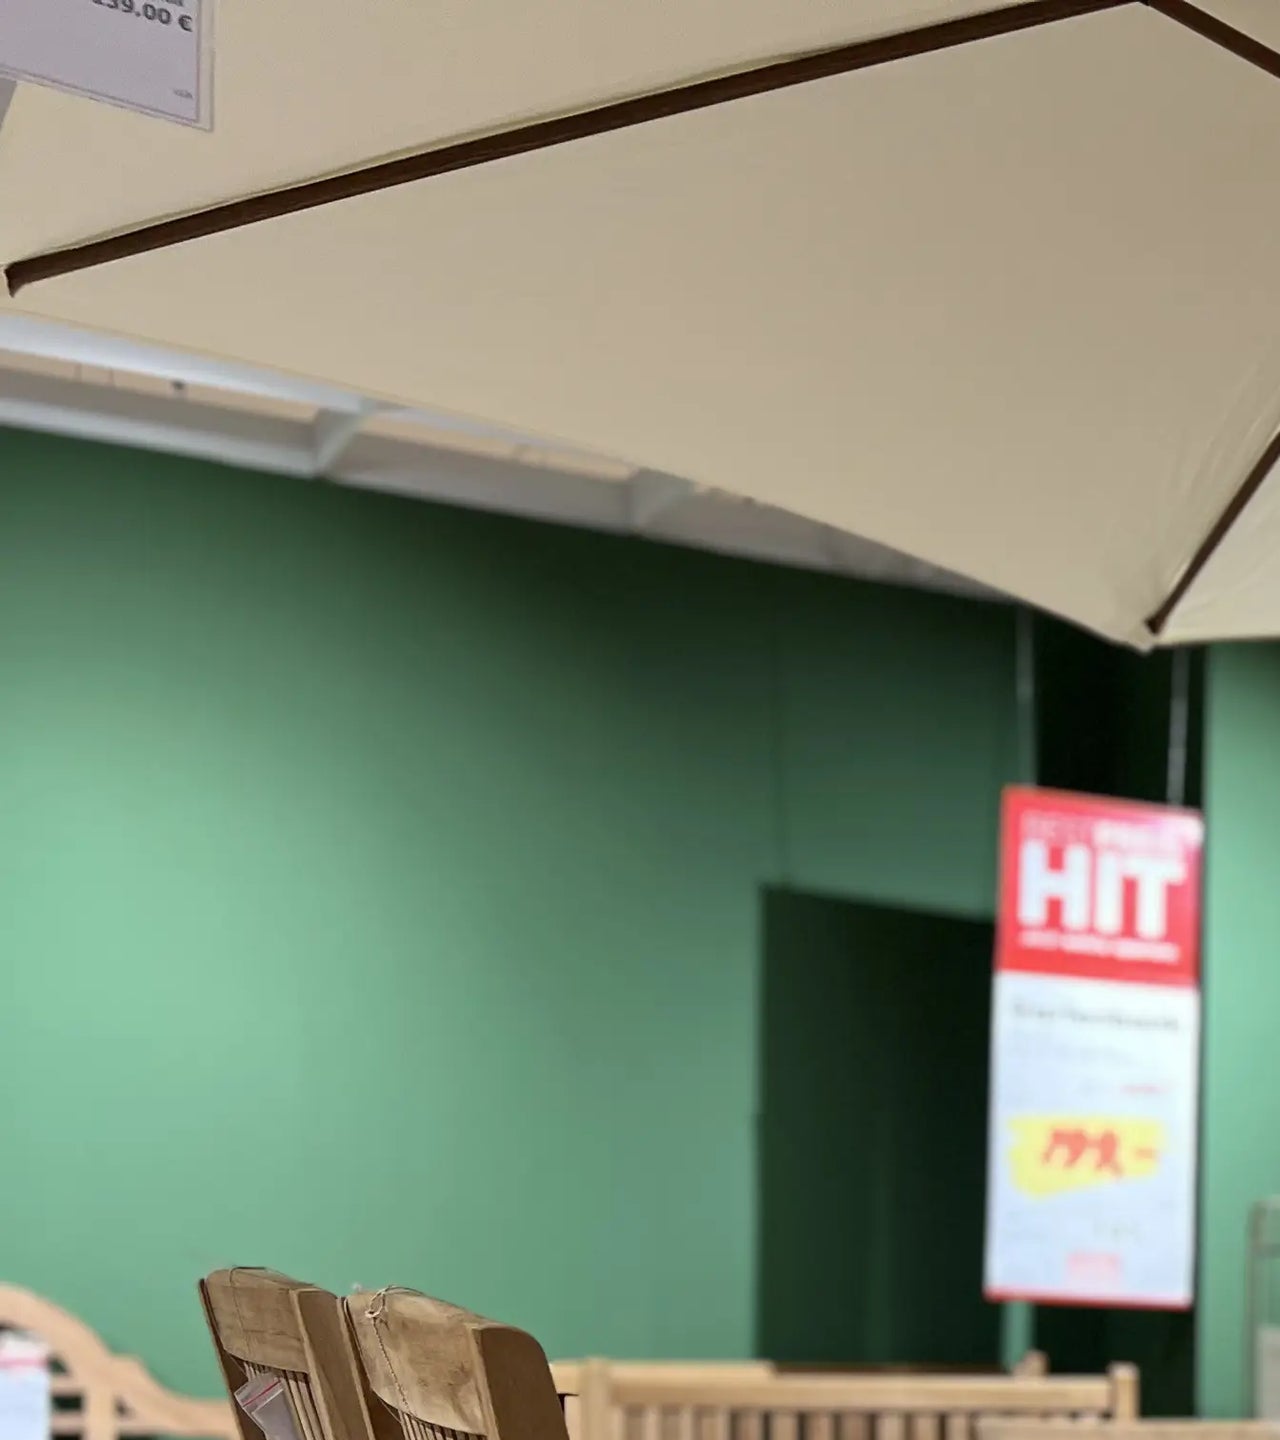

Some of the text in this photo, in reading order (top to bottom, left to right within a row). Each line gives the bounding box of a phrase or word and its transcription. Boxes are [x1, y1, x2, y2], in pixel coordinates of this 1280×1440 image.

[92, 0, 193, 32] 39.00 €
[1017, 838, 1187, 941] HIT
